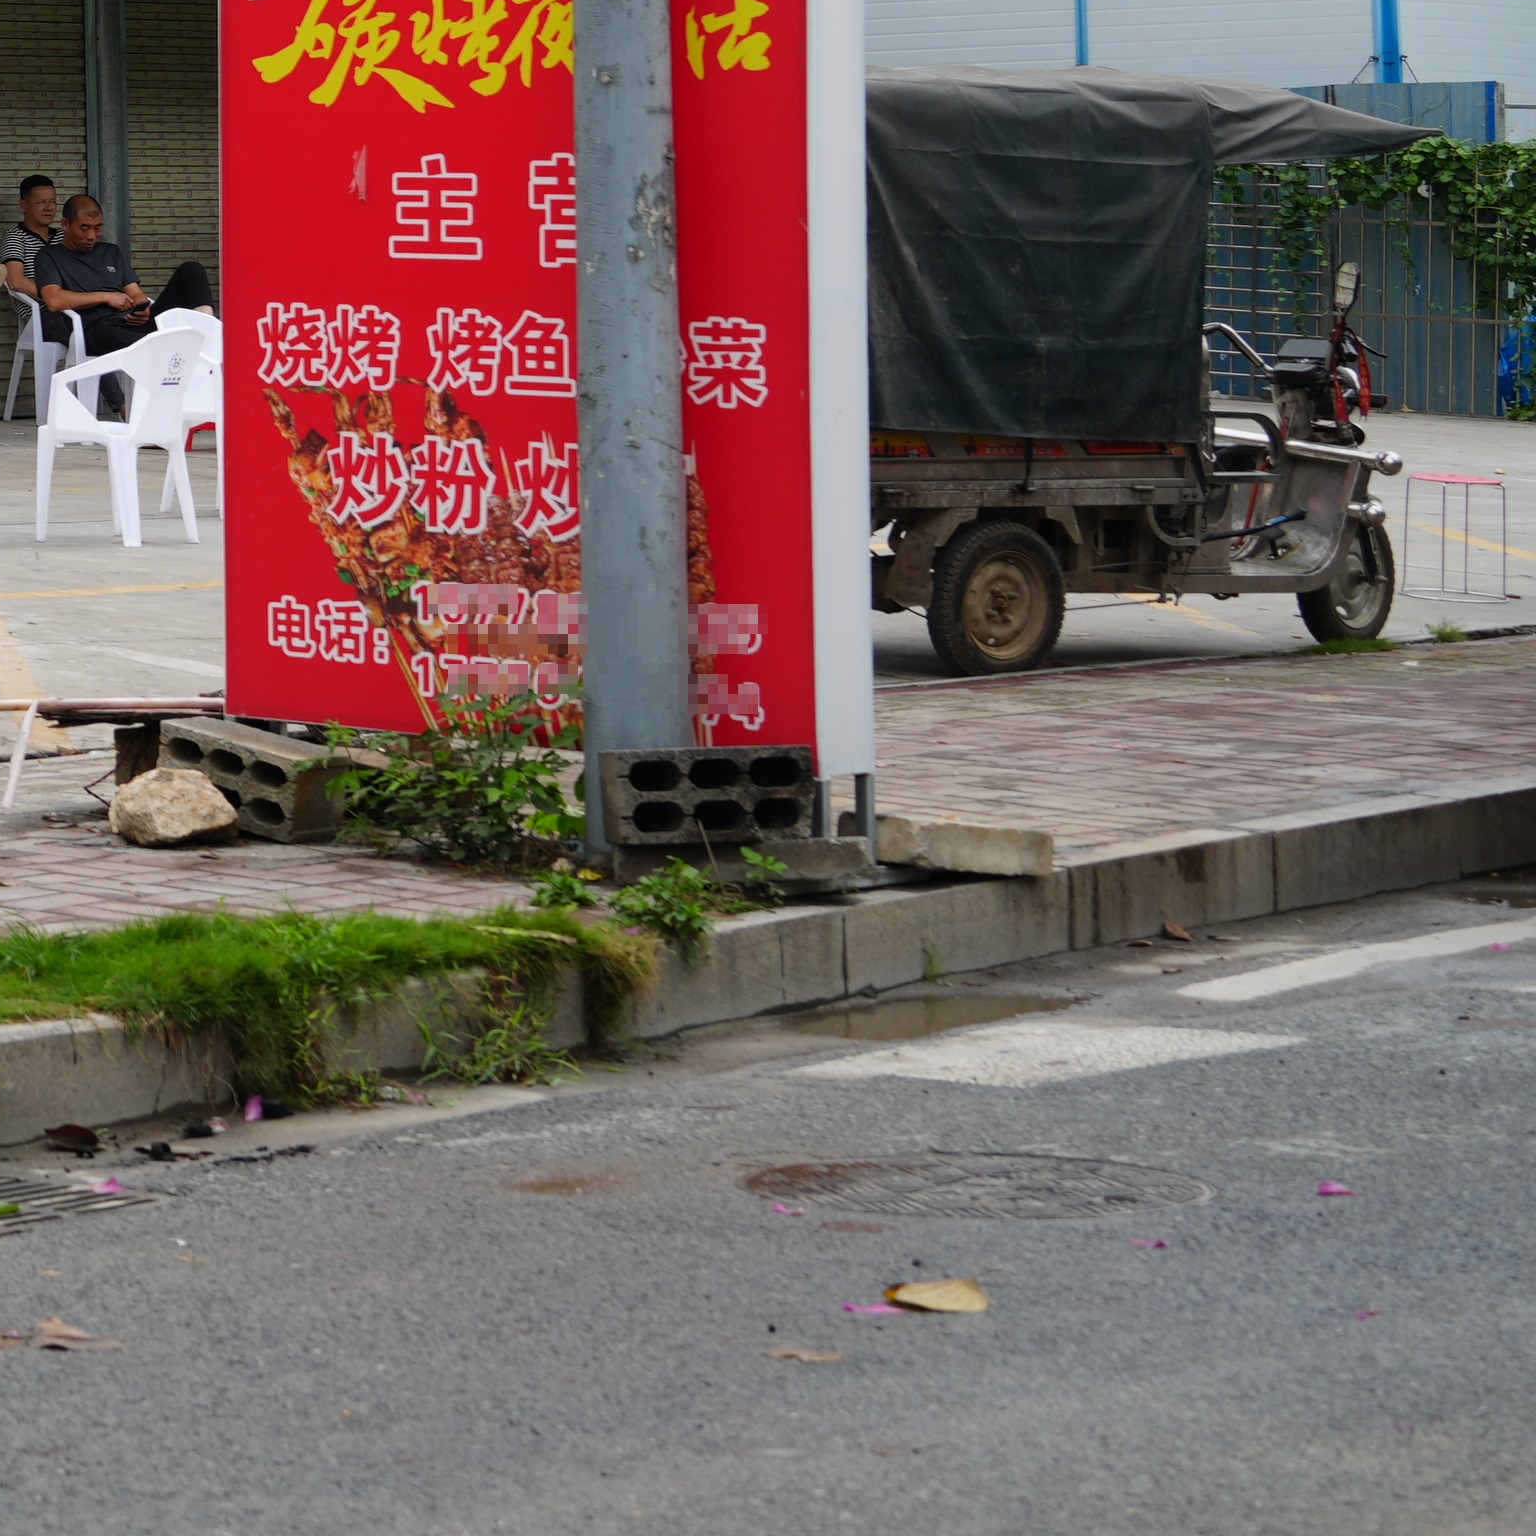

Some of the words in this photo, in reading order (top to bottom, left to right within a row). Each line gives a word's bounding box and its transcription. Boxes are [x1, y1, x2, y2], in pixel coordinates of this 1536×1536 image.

[256, 302, 401, 392] 烧烤
[427, 307, 577, 399] 烤鱼
[678, 316, 769, 409] 菜
[327, 431, 495, 534] 炒粉
